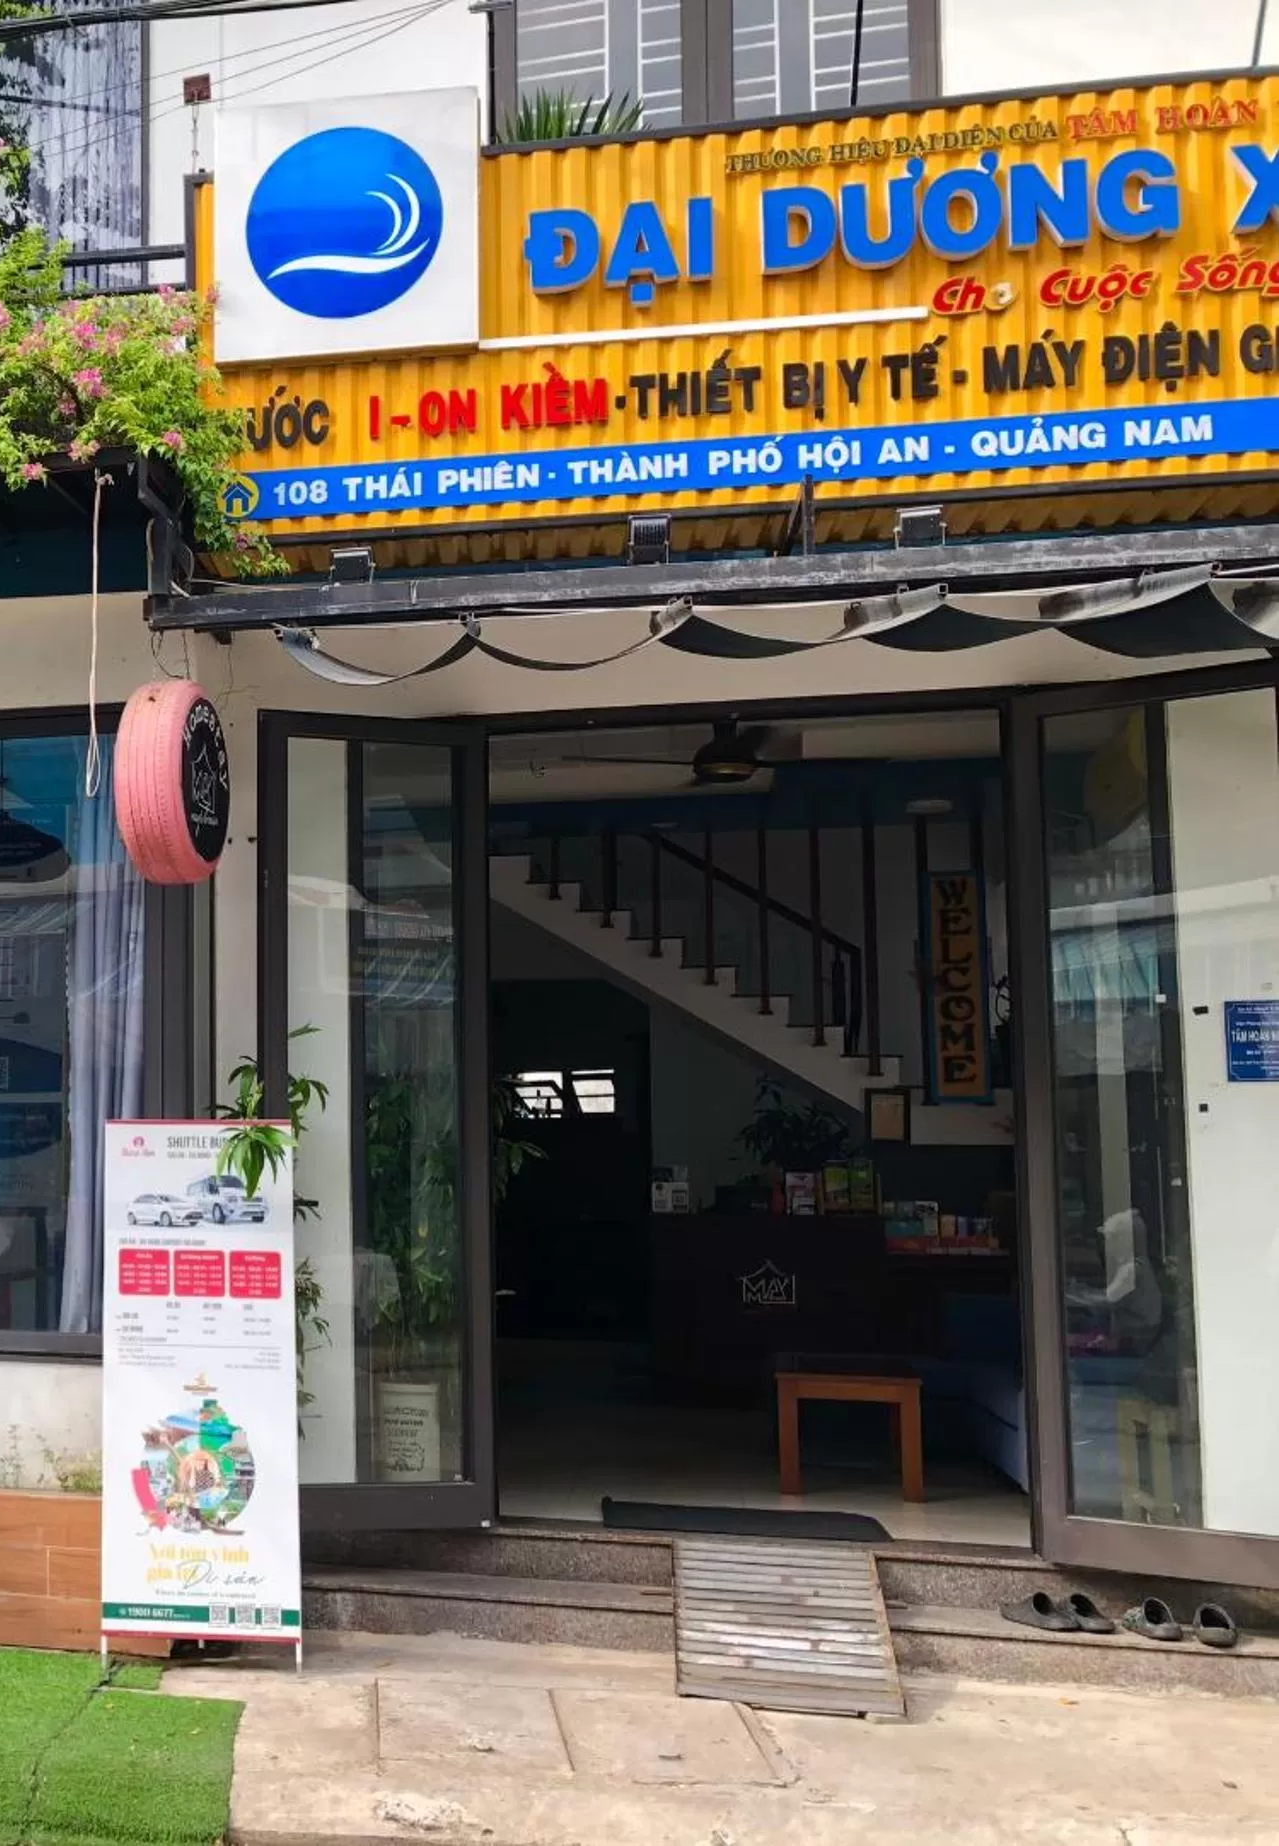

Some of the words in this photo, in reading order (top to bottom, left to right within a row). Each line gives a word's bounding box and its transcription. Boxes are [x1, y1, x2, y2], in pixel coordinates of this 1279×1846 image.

[1067, 107, 1138, 140] TÂM
[525, 196, 715, 308] ĐẠI
[761, 148, 1181, 275] DƯƠNG
[1039, 263, 1154, 313] Cuộc
[246, 385, 331, 452] ƯỚC
[500, 361, 609, 431] KIỀM
[782, 361, 825, 421] BỊ
[836, 357, 869, 406] Y
[881, 335, 948, 402] TẾ
[982, 329, 1086, 394] MÁY
[1101, 321, 1221, 393] ĐIỆN
[273, 479, 328, 506] 108
[343, 464, 422, 502] THÁI
[437, 461, 540, 495] PHIÊN
[568, 451, 688, 485] THÀNH
[708, 435, 784, 476] PHỐ
[798, 434, 862, 474] HỘI
[877, 435, 930, 465] AN
[971, 417, 1107, 458] QUẢNG
[1124, 414, 1213, 447] NAM
[936, 876, 977, 1084] WELCOME
[167, 1135, 208, 1149] SHUTTLE
